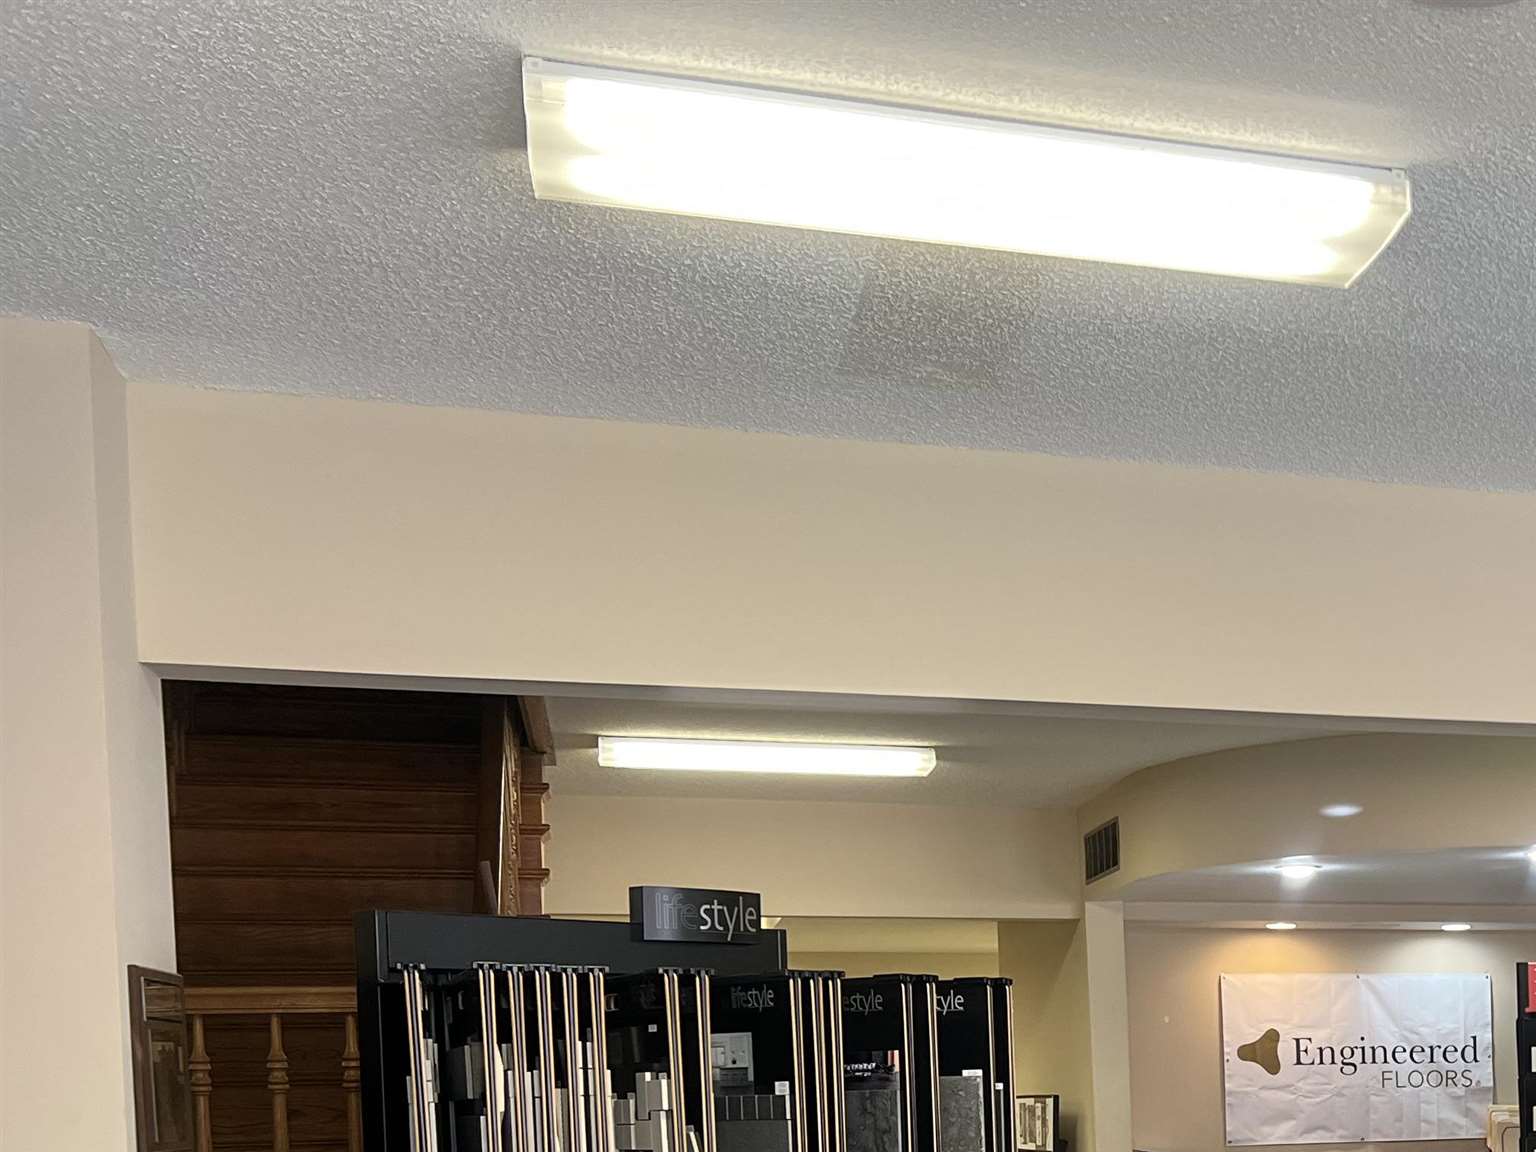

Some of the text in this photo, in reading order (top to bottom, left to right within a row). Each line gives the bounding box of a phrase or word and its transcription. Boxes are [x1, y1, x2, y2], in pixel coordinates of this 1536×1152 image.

[655, 892, 757, 941] lifestyle
[1293, 1035, 1480, 1076] Engineered
[1381, 1069, 1473, 1088] FLOORS
